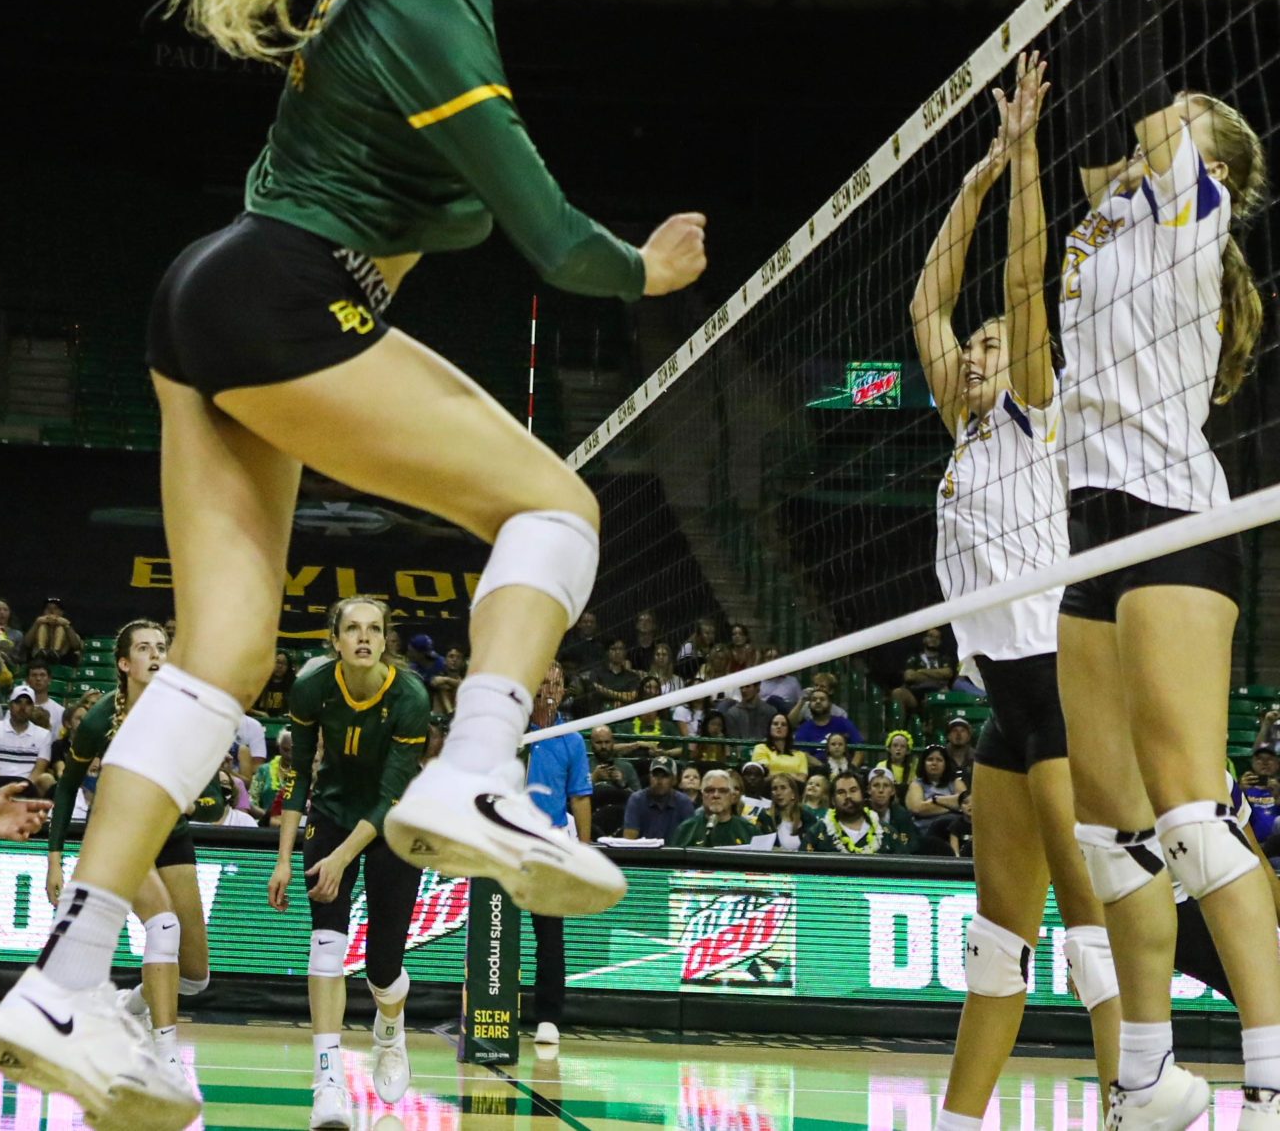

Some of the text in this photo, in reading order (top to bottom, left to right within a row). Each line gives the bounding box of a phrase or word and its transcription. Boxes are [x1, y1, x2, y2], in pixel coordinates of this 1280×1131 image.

[344, 726, 362, 755] 11
[487, 893, 503, 996] sports imports
[474, 1010, 510, 1024] SIC'EM
[473, 1024, 510, 1039] BEARS
